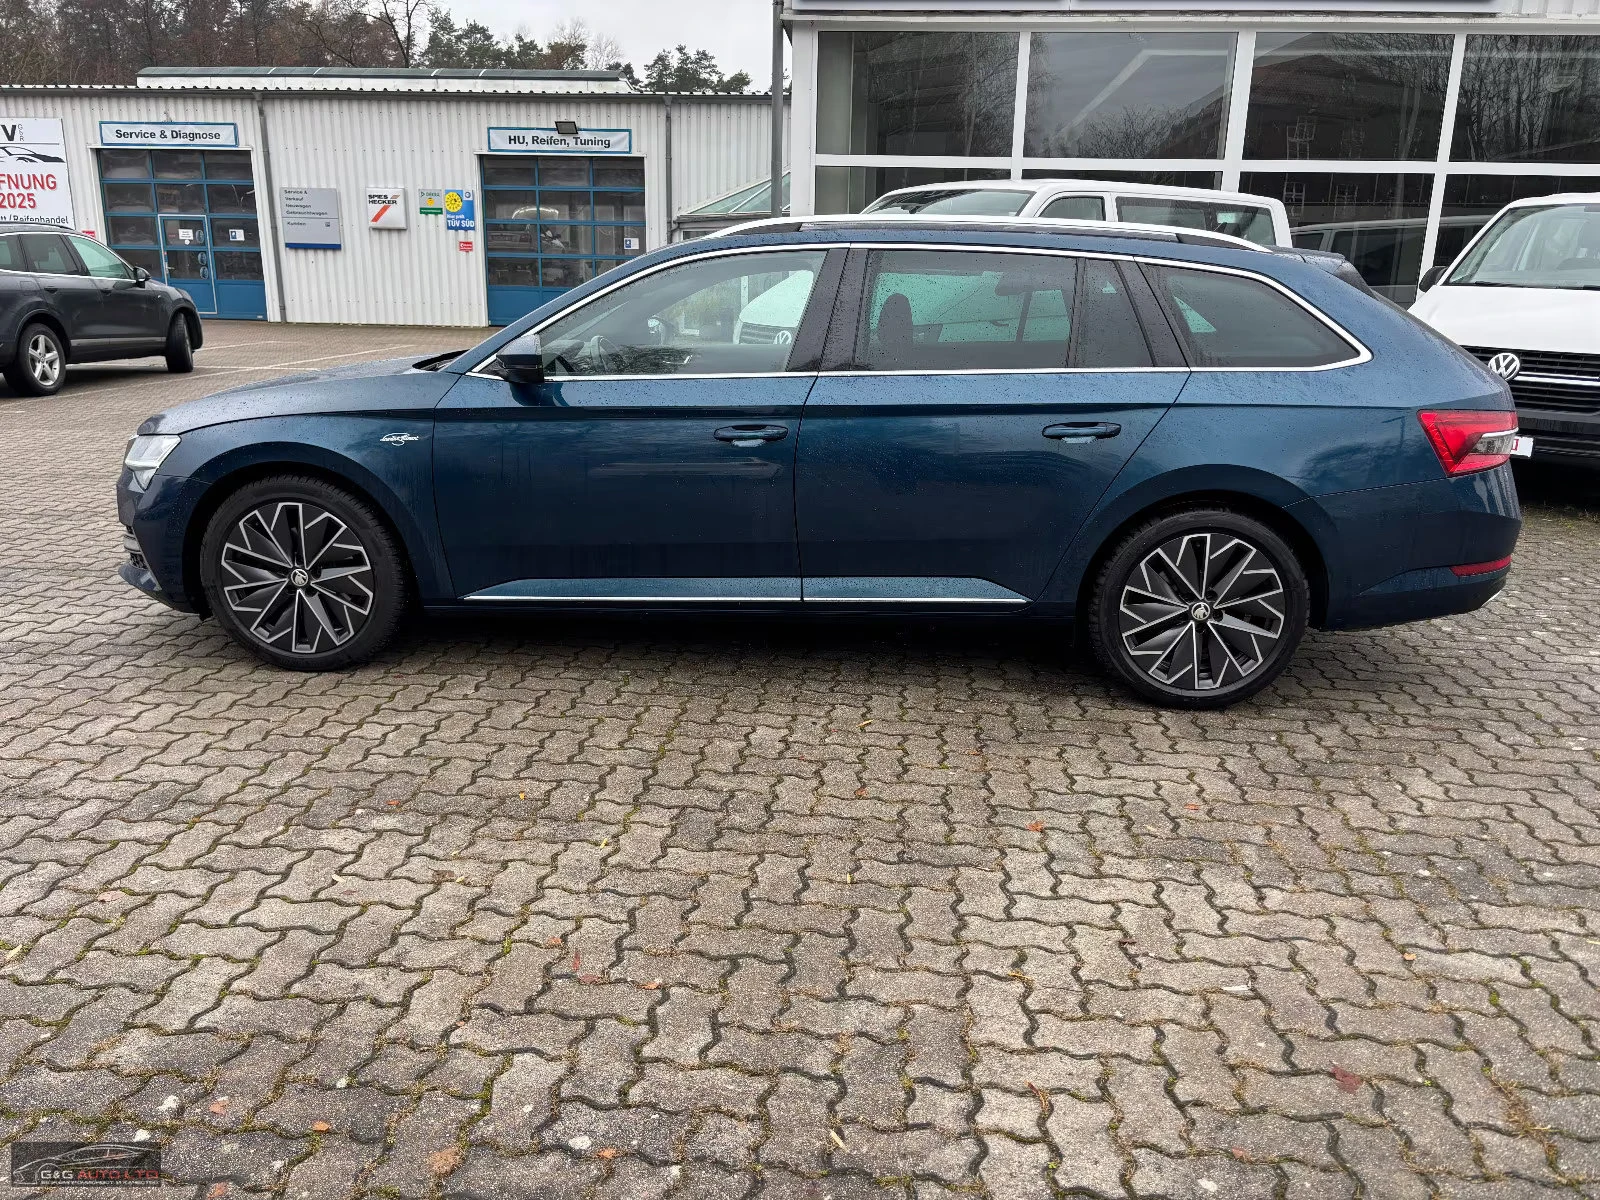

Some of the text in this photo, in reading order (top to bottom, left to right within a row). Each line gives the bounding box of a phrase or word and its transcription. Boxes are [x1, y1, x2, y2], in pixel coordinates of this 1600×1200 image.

[115, 129, 221, 141] Service & Diagnose
[508, 135, 610, 148] HU, Reifen, Tuning
[0, 192, 36, 208] 2025
[461, 219, 474, 227] SÜD
